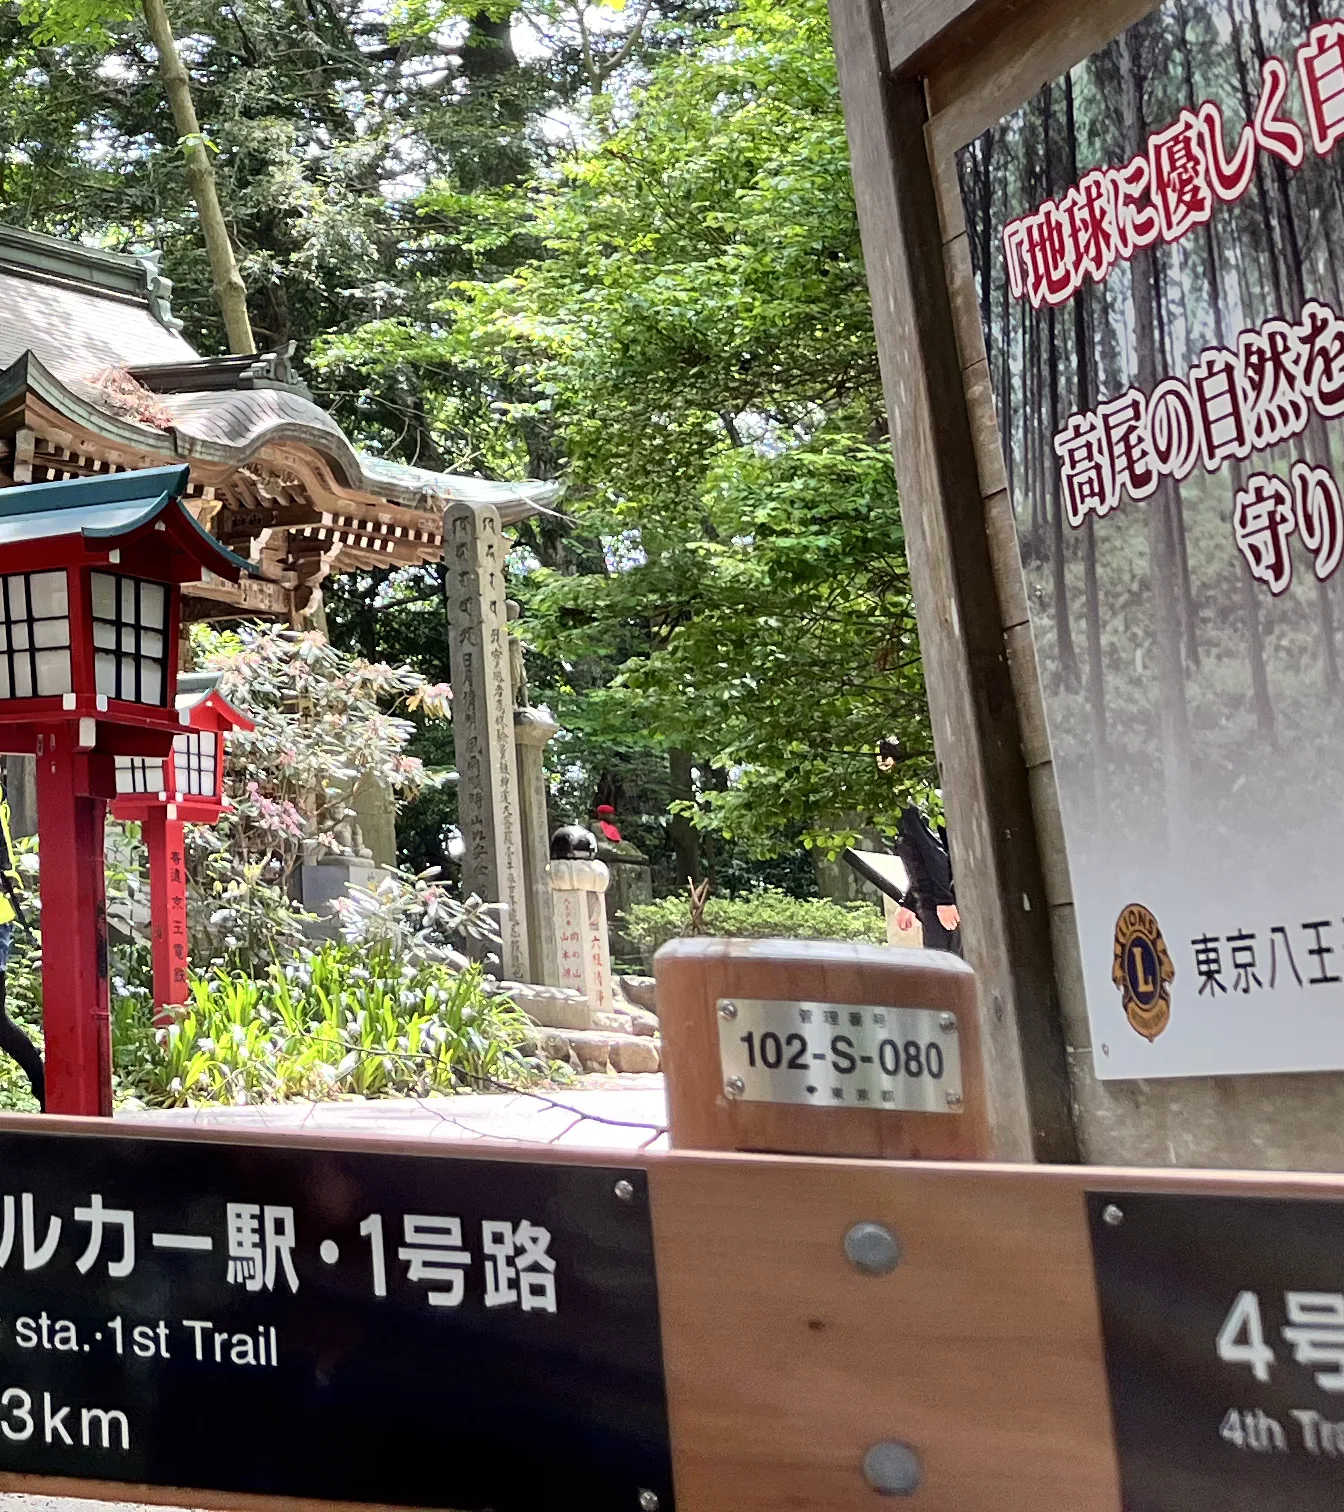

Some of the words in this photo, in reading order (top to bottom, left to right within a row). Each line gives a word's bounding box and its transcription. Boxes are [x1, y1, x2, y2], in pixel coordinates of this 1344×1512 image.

[1117, 909, 1157, 938] LIONS
[1132, 946, 1156, 994] L
[1190, 918, 1344, 998] 東京八王
[739, 1029, 945, 1080] 102-S-080
[181, 1318, 279, 1368] Trail
[1218, 1406, 1288, 1453] 4th
[1287, 1408, 1344, 1456] Tr
